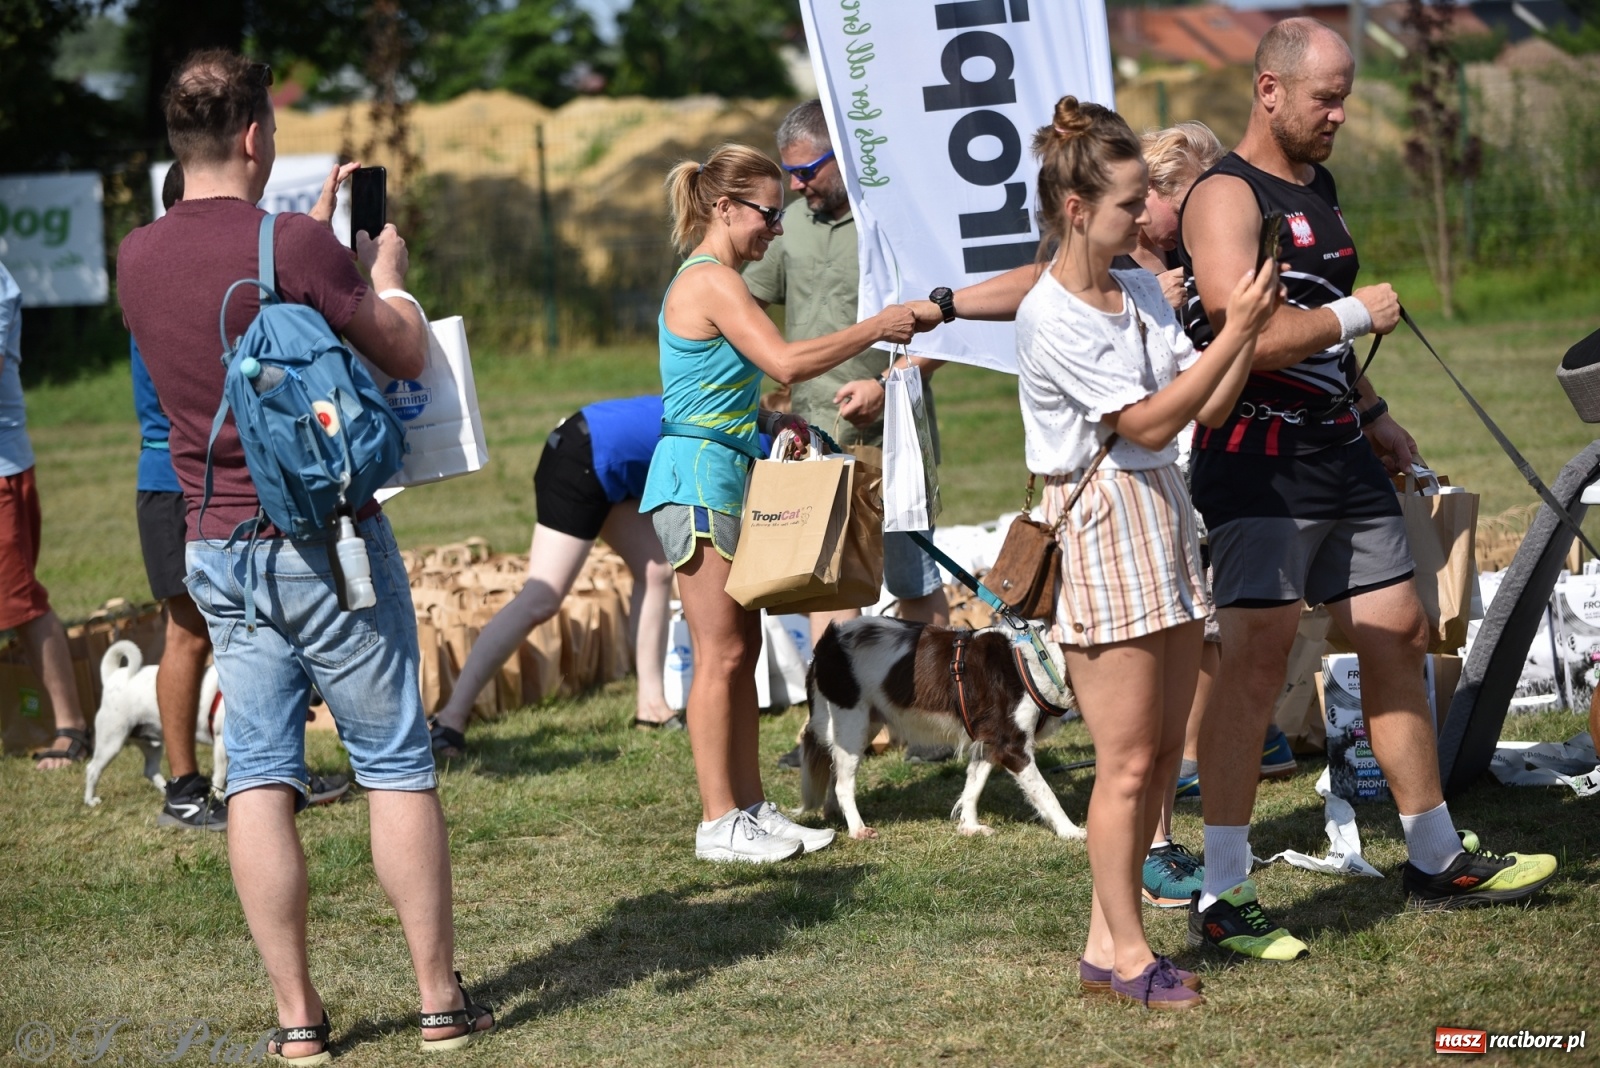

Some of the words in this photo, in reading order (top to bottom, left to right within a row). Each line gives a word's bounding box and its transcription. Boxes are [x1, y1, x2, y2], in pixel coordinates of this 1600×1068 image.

[751, 509, 800, 523] TropiCat
[422, 1014, 454, 1026] adidas
[287, 1028, 317, 1040] adidas
